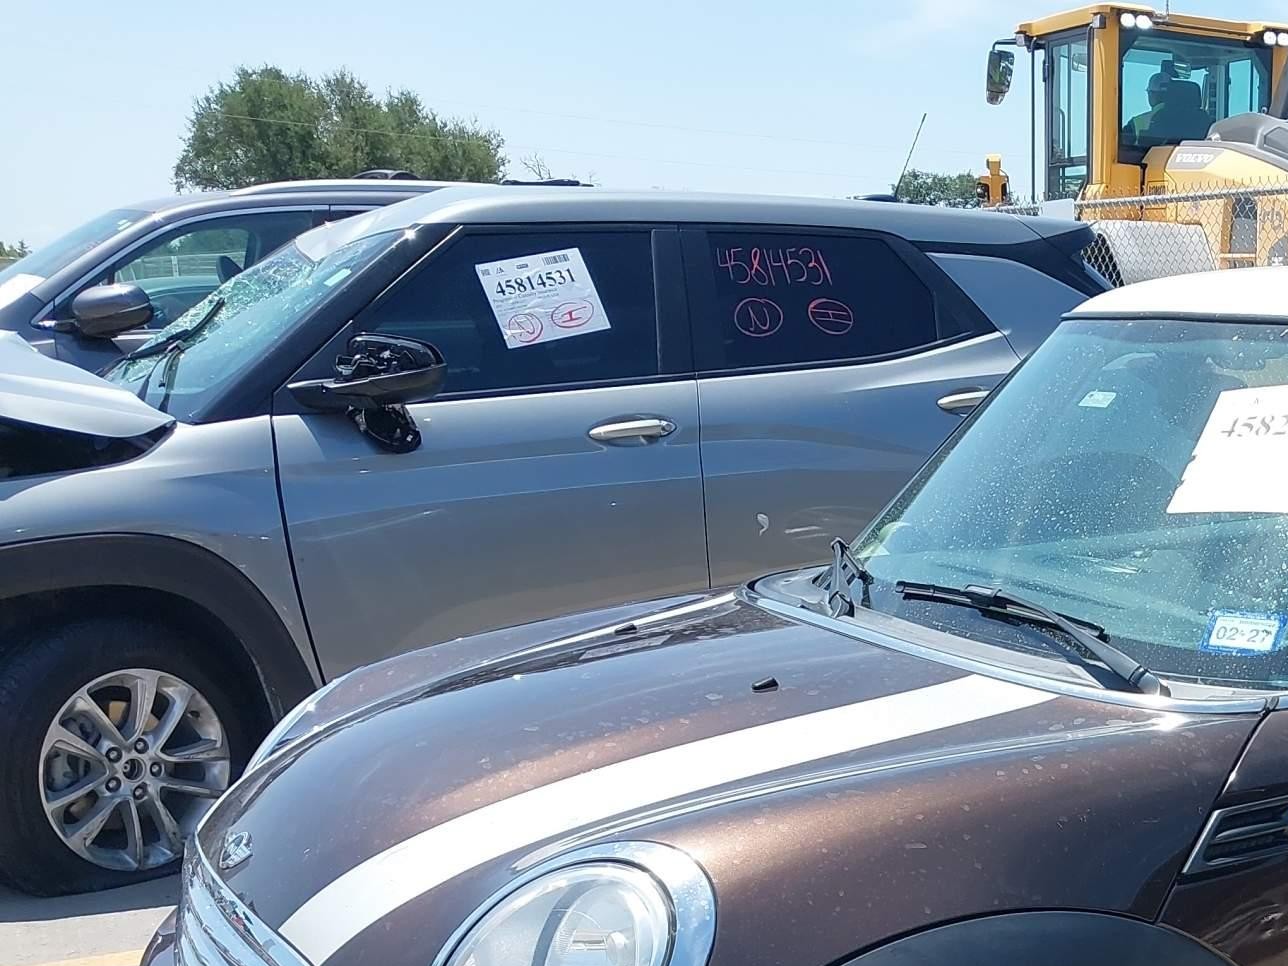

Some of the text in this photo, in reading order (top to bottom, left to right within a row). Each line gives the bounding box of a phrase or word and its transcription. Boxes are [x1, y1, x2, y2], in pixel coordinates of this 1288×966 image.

[1175, 152, 1214, 163] VOLVO
[717, 247, 832, 286] 45814531
[495, 267, 576, 297] 45814531
